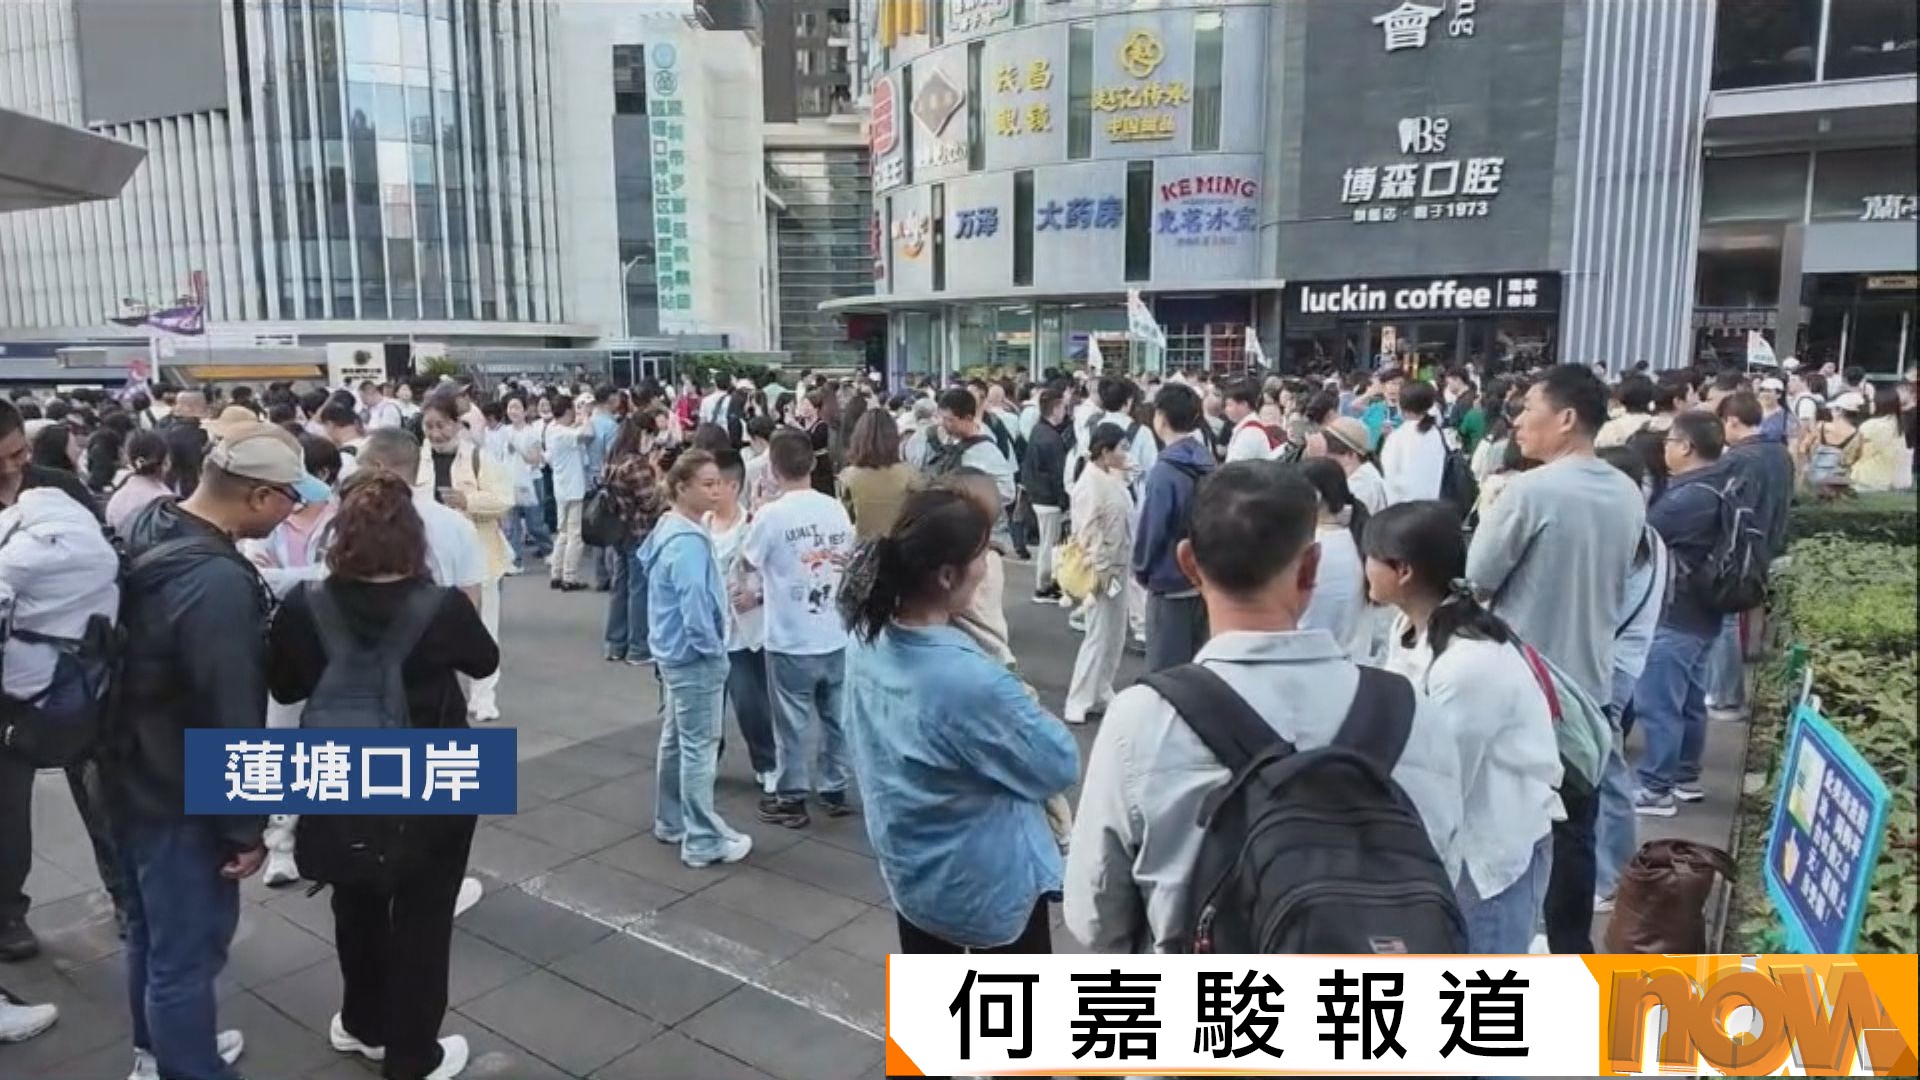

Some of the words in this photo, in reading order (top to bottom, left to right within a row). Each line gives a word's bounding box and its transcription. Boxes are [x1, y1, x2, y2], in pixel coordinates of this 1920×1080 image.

[1371, 2, 1445, 50] 會
[1160, 178, 1193, 202] KE
[1341, 157, 1504, 203] 博森口腔
[955, 207, 999, 240] 万泽
[1036, 195, 1124, 232] 大药房
[1301, 284, 1386, 312] luckin
[1395, 280, 1491, 309] coffee
